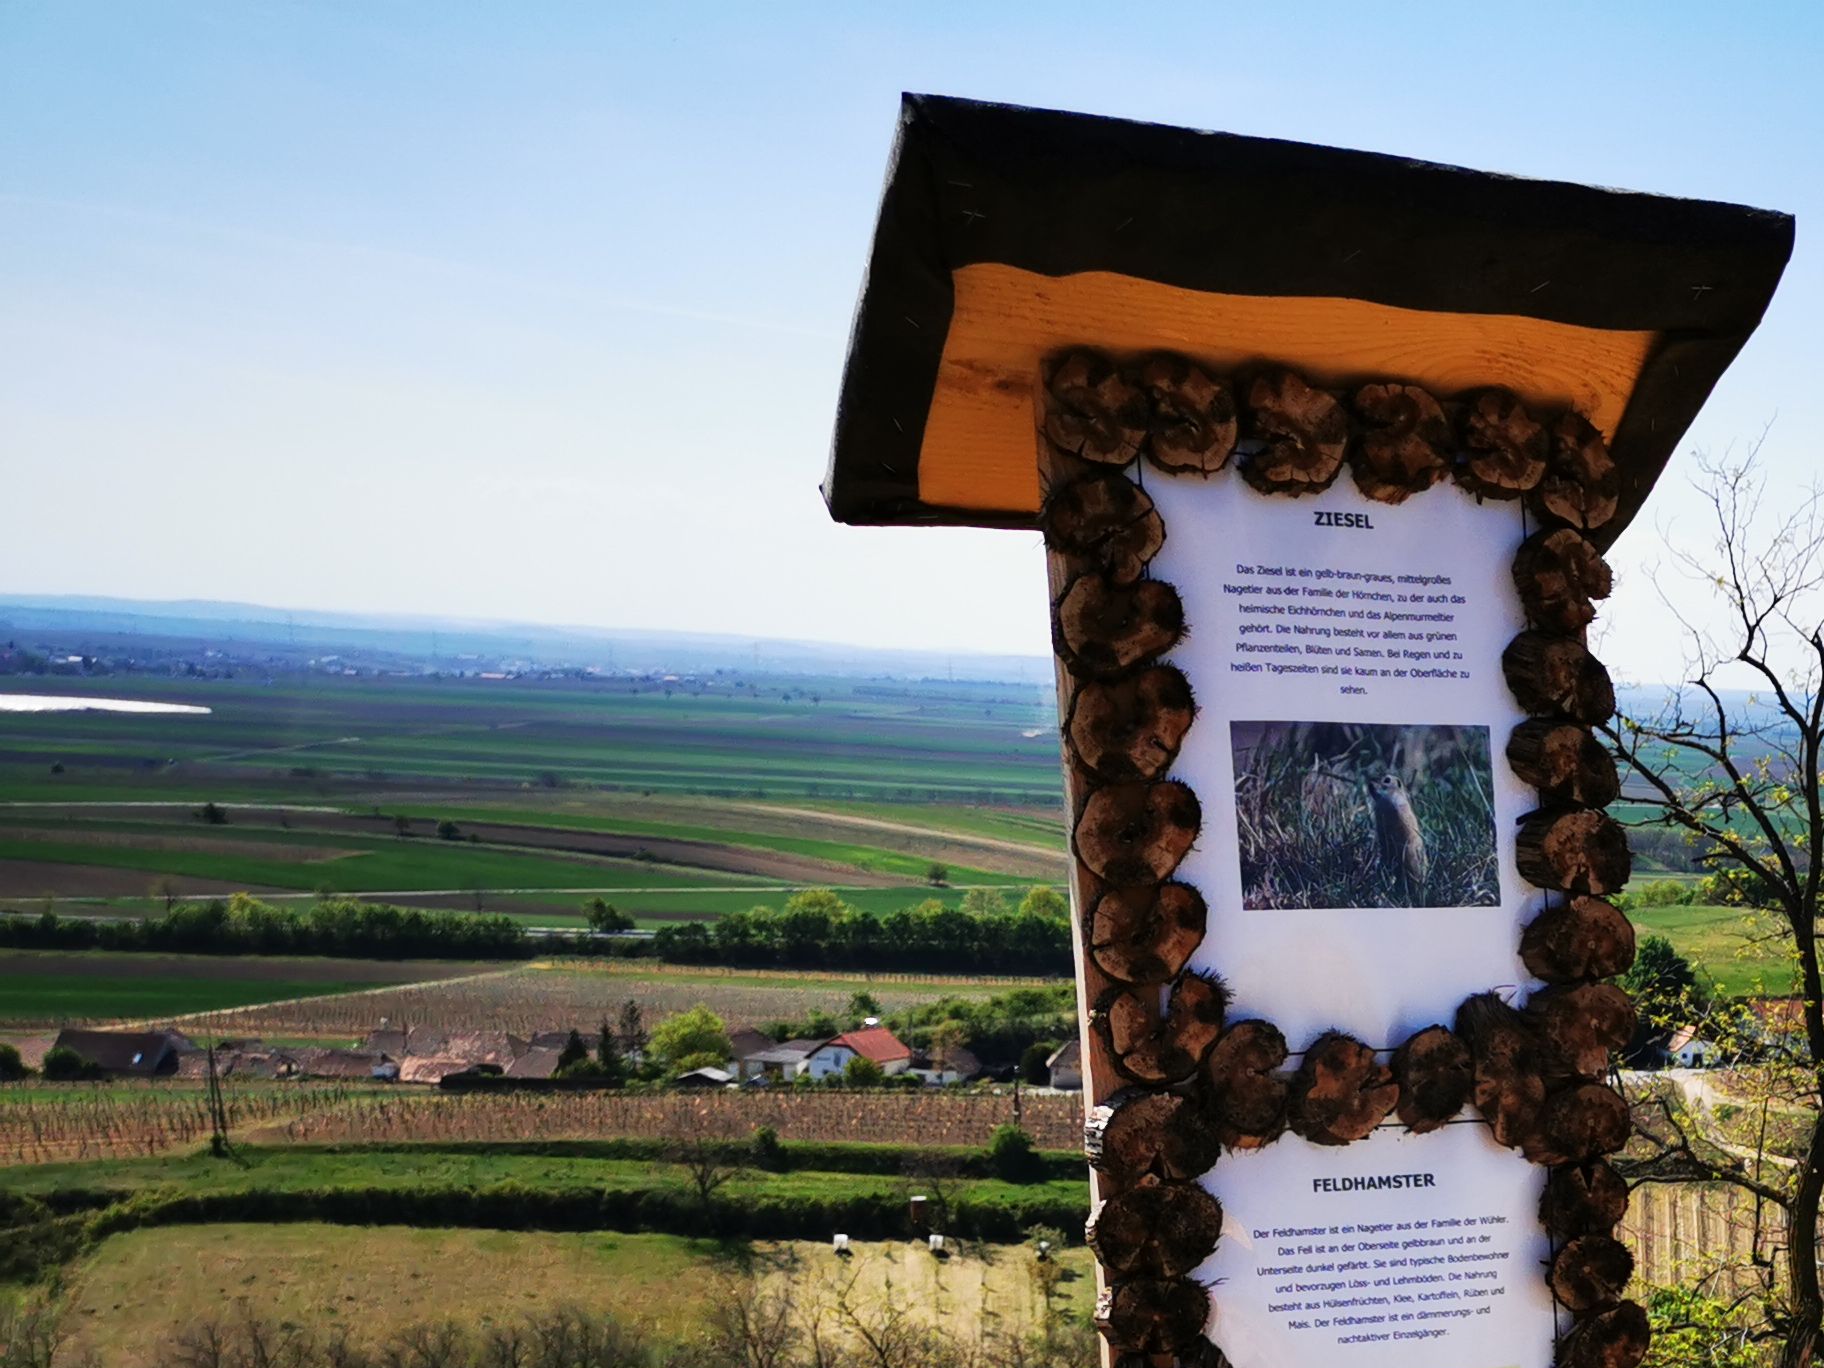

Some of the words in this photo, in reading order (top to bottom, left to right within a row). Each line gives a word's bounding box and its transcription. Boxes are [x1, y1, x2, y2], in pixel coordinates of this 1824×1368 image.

[1314, 512, 1374, 529] ZIESEL
[1237, 564, 1254, 574] Das
[1257, 565, 1282, 576] Ziesel
[1285, 568, 1296, 576] ist
[1299, 568, 1312, 577] ein
[1223, 584, 1263, 596] Nagetier
[1266, 587, 1282, 595] aus
[1284, 586, 1300, 595] der
[1336, 589, 1350, 598] der
[1410, 594, 1424, 602] der
[1427, 594, 1448, 603] auch
[1451, 595, 1465, 604] das
[1239, 604, 1285, 614] heimische
[1288, 605, 1346, 617] Eichhörnchen
[1349, 610, 1364, 618] und
[1367, 610, 1381, 620] das
[1384, 611, 1454, 622] Alpenmurmeltier
[1276, 624, 1291, 634] Die
[1294, 625, 1330, 638] Nahrung
[1333, 627, 1364, 638] besteht
[1383, 630, 1406, 639] allem
[1426, 632, 1457, 642] grünen
[1305, 645, 1333, 655] Blüten
[1335, 647, 1351, 656] und
[1387, 649, 1400, 658] Bei
[1434, 650, 1450, 659] und
[1231, 662, 1262, 672] heißen
[1266, 663, 1319, 674] Tageszeiten
[1321, 665, 1338, 674] sind
[1341, 667, 1352, 675] sie
[1355, 667, 1377, 676] kaum
[1394, 669, 1408, 677] der
[1410, 668, 1457, 678] Oberfläche
[1313, 1174, 1435, 1192] FELDHAMSTER
[1253, 1230, 1269, 1239] Der
[1273, 1227, 1326, 1237] Feldhamster
[1329, 1226, 1339, 1234] ist
[1357, 1224, 1393, 1234] Nagetier
[1414, 1221, 1428, 1229] der
[1431, 1218, 1461, 1228] Familie
[1463, 1218, 1476, 1226] der
[1278, 1247, 1294, 1256] Das
[1315, 1245, 1325, 1253] ist
[1341, 1244, 1355, 1252] der
[1358, 1241, 1399, 1251] Oberseite
[1402, 1239, 1445, 1250] gelbbraun
[1448, 1236, 1463, 1245] und
[1478, 1235, 1491, 1243] der
[1257, 1266, 1303, 1276] Unterseite
[1306, 1263, 1334, 1273] dunkel
[1373, 1259, 1387, 1268] Sie
[1389, 1258, 1407, 1267] sind
[1410, 1256, 1445, 1267] typische
[1275, 1284, 1292, 1293] und
[1296, 1282, 1346, 1292] bevorzugen
[1374, 1277, 1390, 1286] und
[1448, 1272, 1461, 1281] Die
[1464, 1271, 1497, 1279] Nahrung
[1268, 1302, 1302, 1312] besteht
[1305, 1302, 1320, 1310] aus
[1491, 1287, 1504, 1295] und
[1315, 1319, 1330, 1328] Der
[1333, 1316, 1385, 1326] Feldhamster
[1417, 1309, 1473, 1319] dämmerungs-
[1476, 1306, 1490, 1314] und
[1338, 1334, 1390, 1343] nachtaktiver
